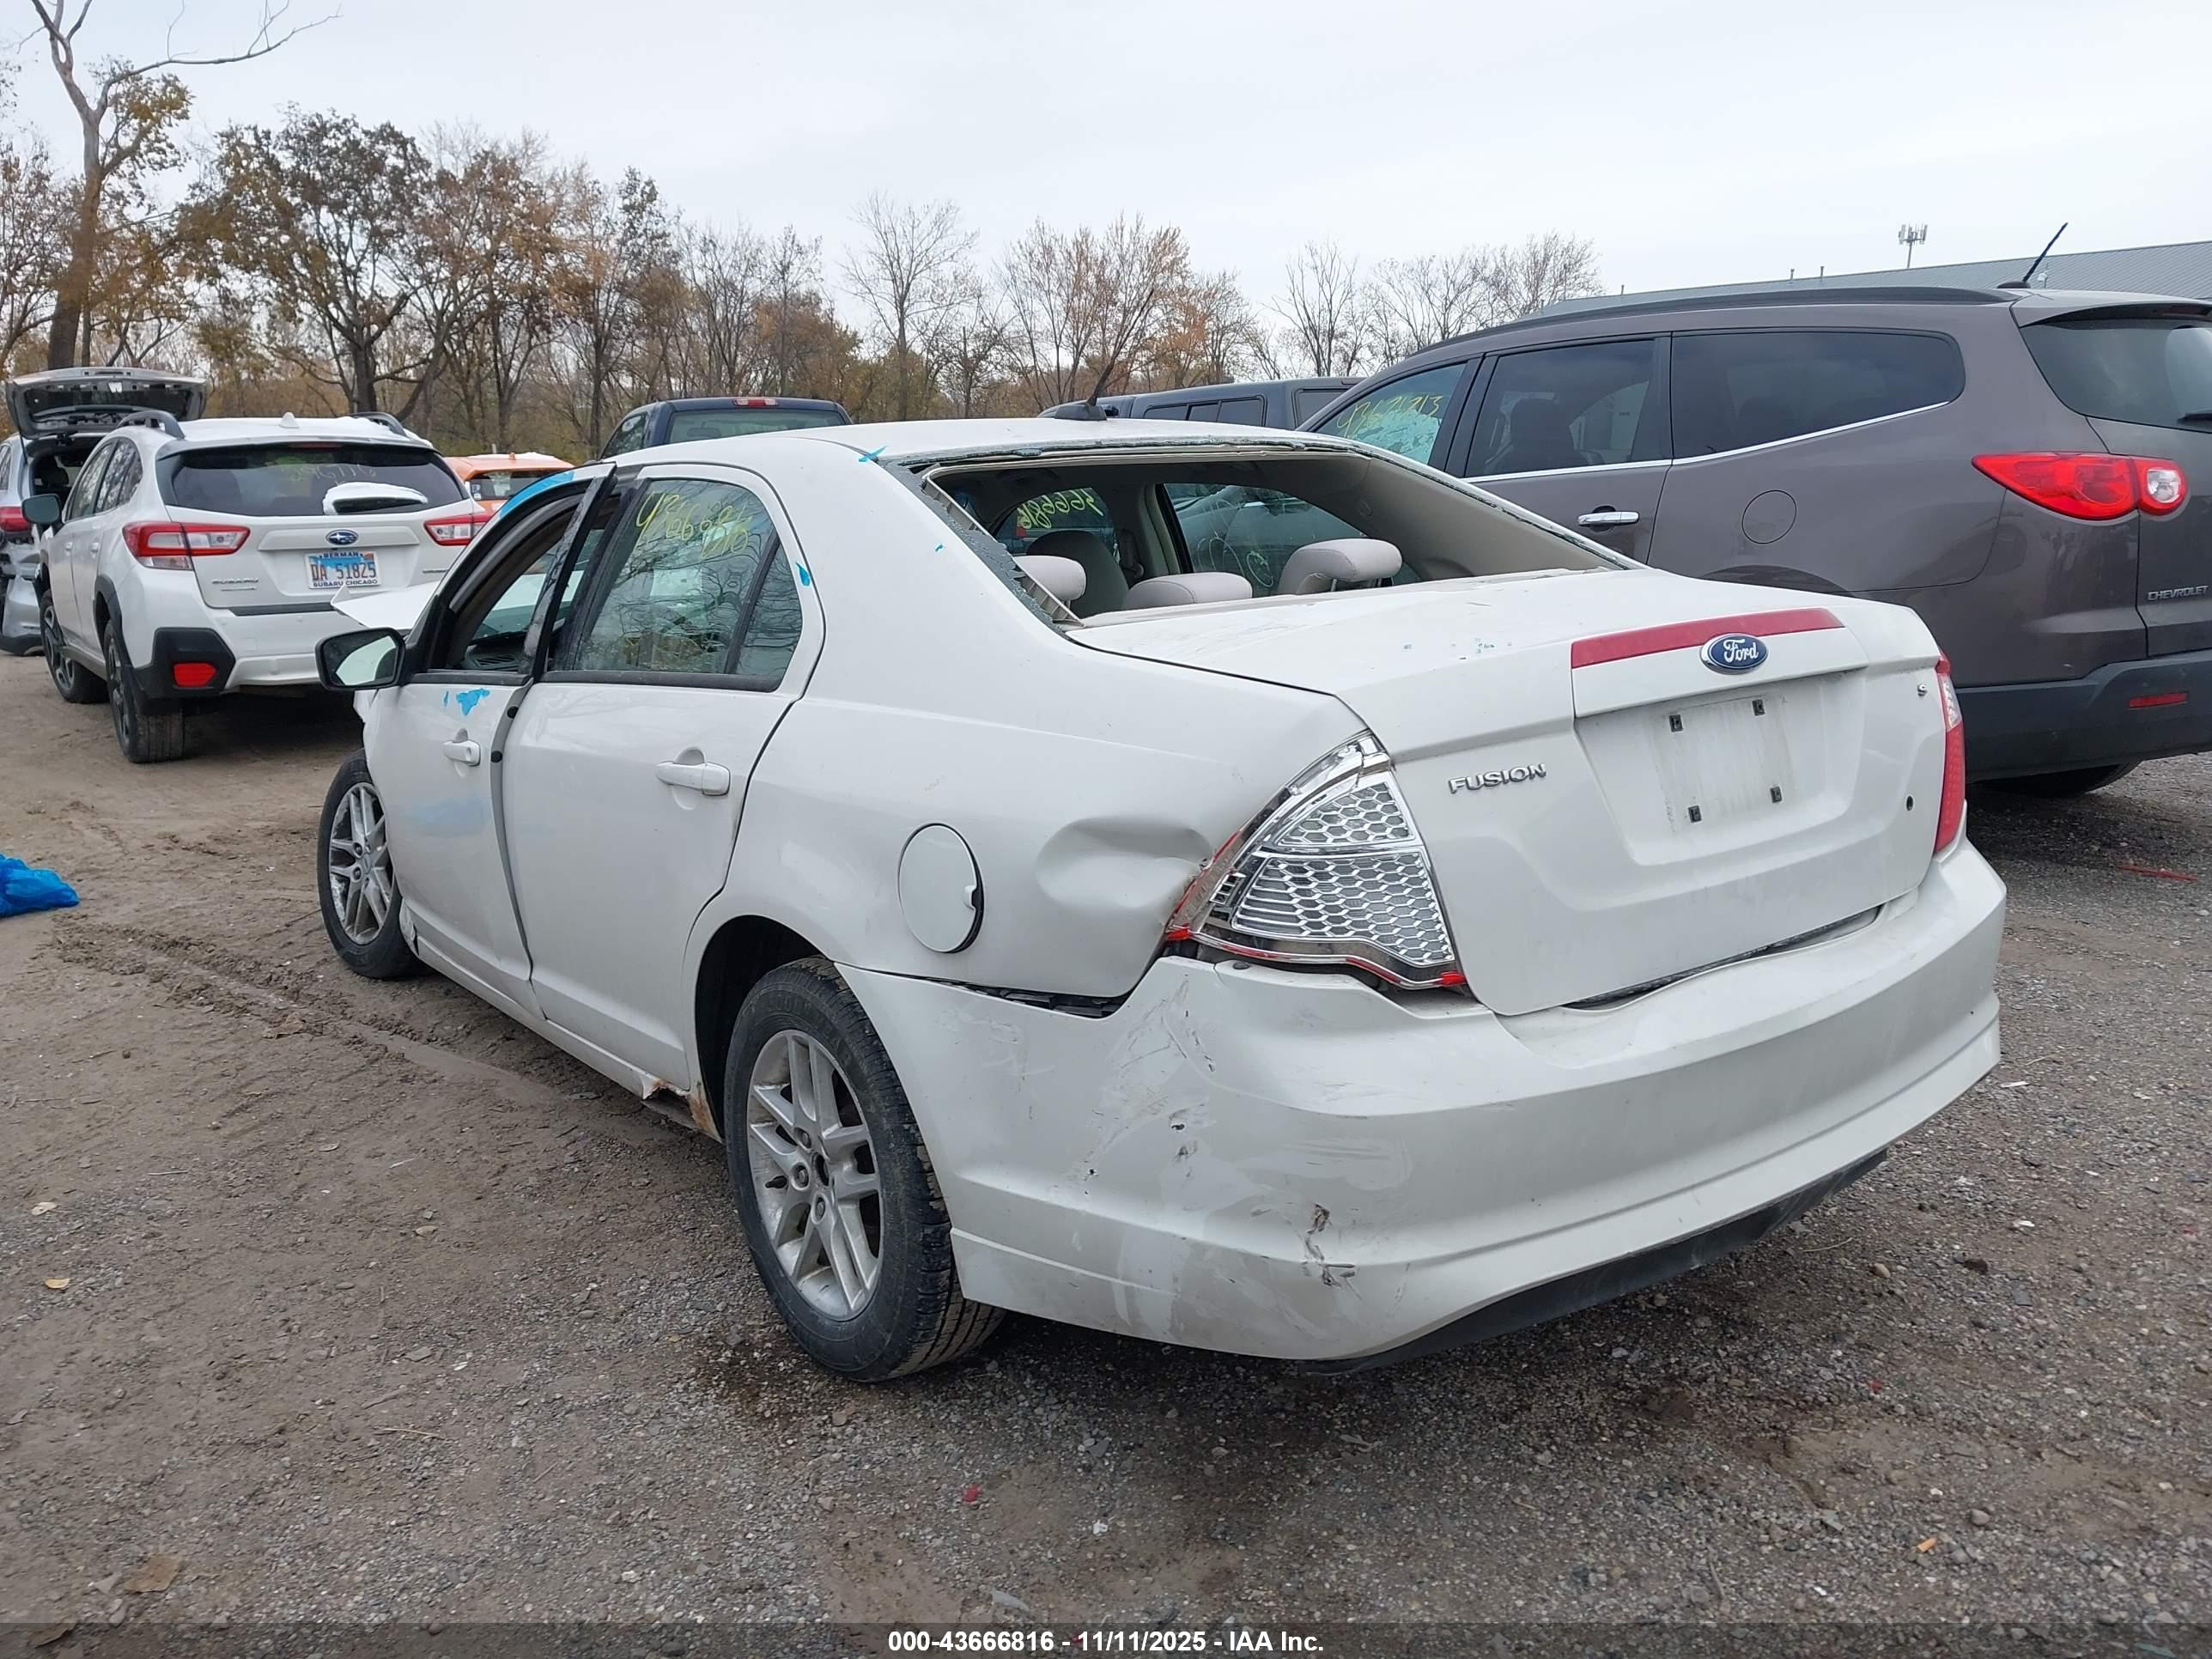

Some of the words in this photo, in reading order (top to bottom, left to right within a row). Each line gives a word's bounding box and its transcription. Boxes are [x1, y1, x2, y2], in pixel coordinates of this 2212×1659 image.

[310, 563, 328, 581] DA
[336, 562, 377, 580] 51825
[2148, 585, 2209, 601] CHEVROLET
[1723, 638, 1759, 663] Ford
[1448, 763, 1547, 794] FUSION
